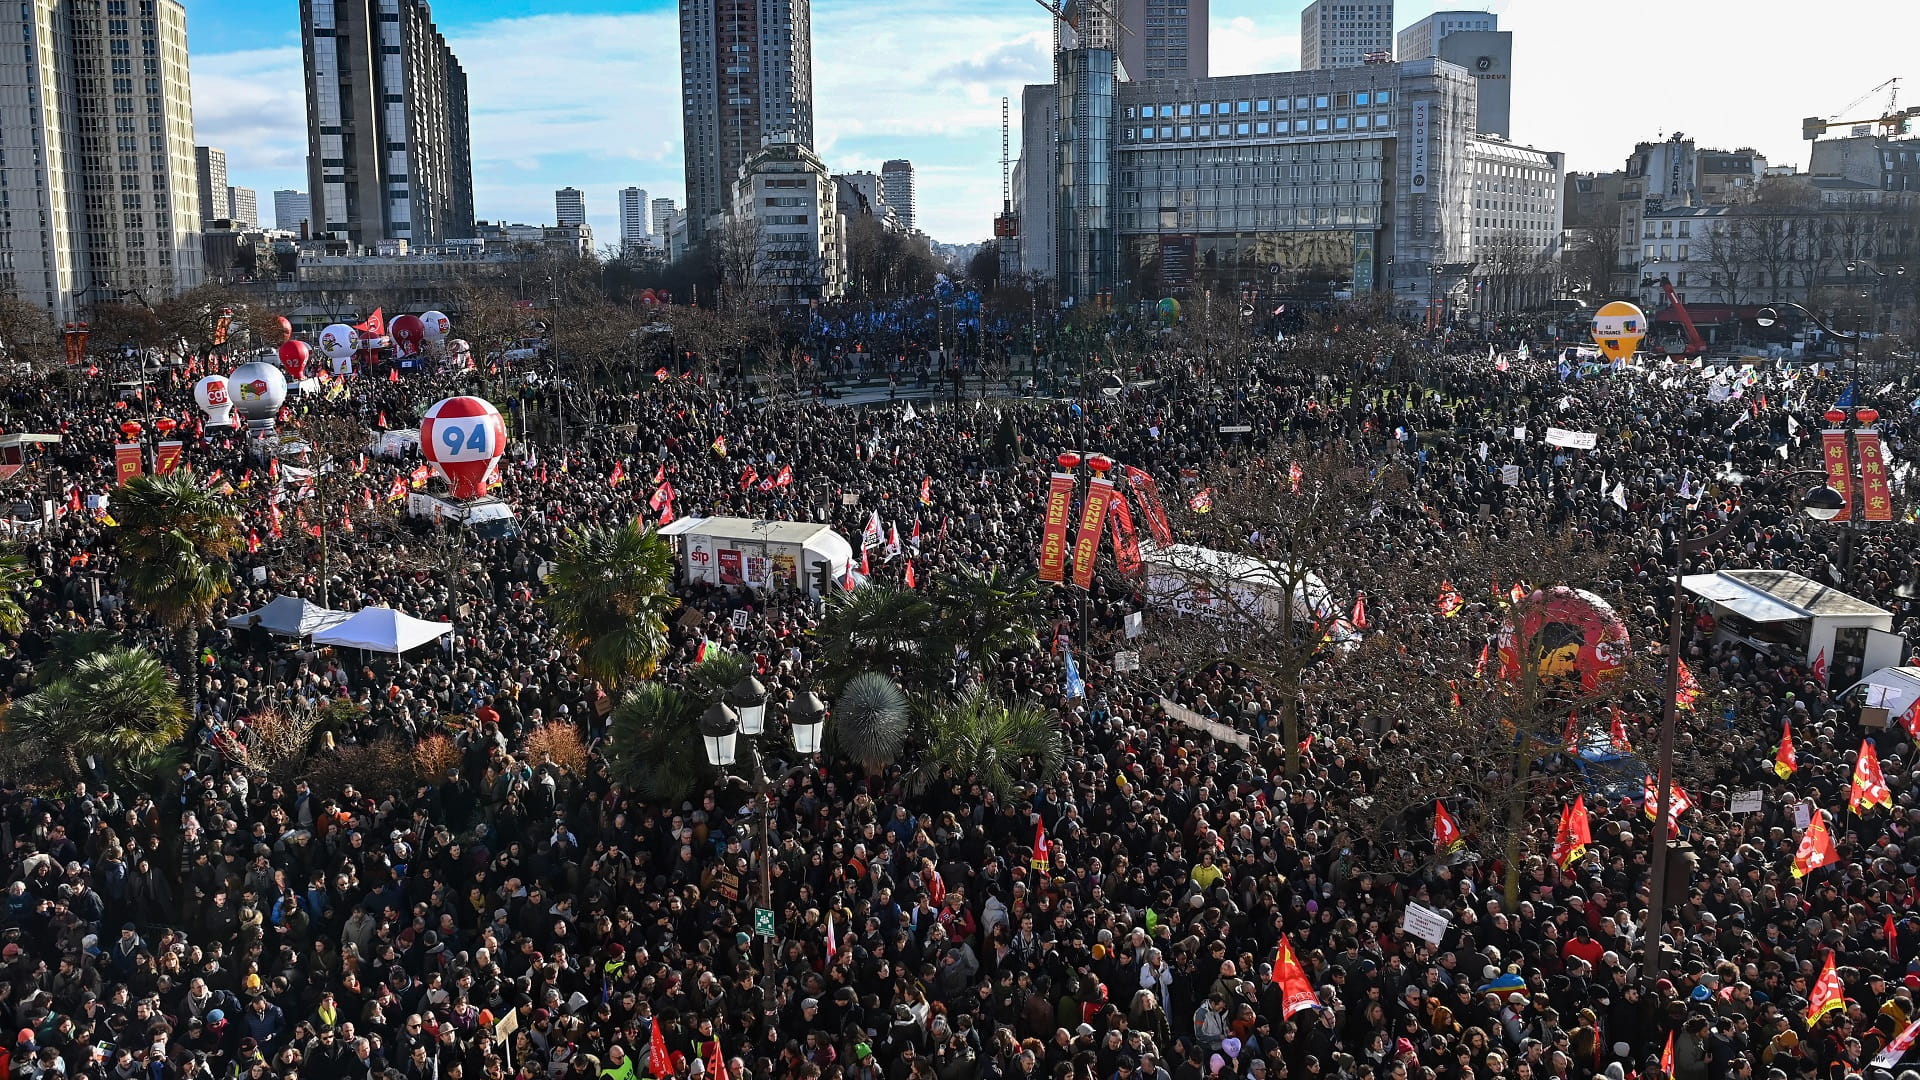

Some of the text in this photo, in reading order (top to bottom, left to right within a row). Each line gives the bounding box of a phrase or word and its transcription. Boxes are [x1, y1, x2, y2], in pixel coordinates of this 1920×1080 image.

[286, 359, 299, 368] 92
[442, 423, 486, 456] 94
[1829, 446, 1846, 493] 好運連
[1049, 492, 1065, 525] BONNE
[1083, 497, 1103, 532] BONNE
